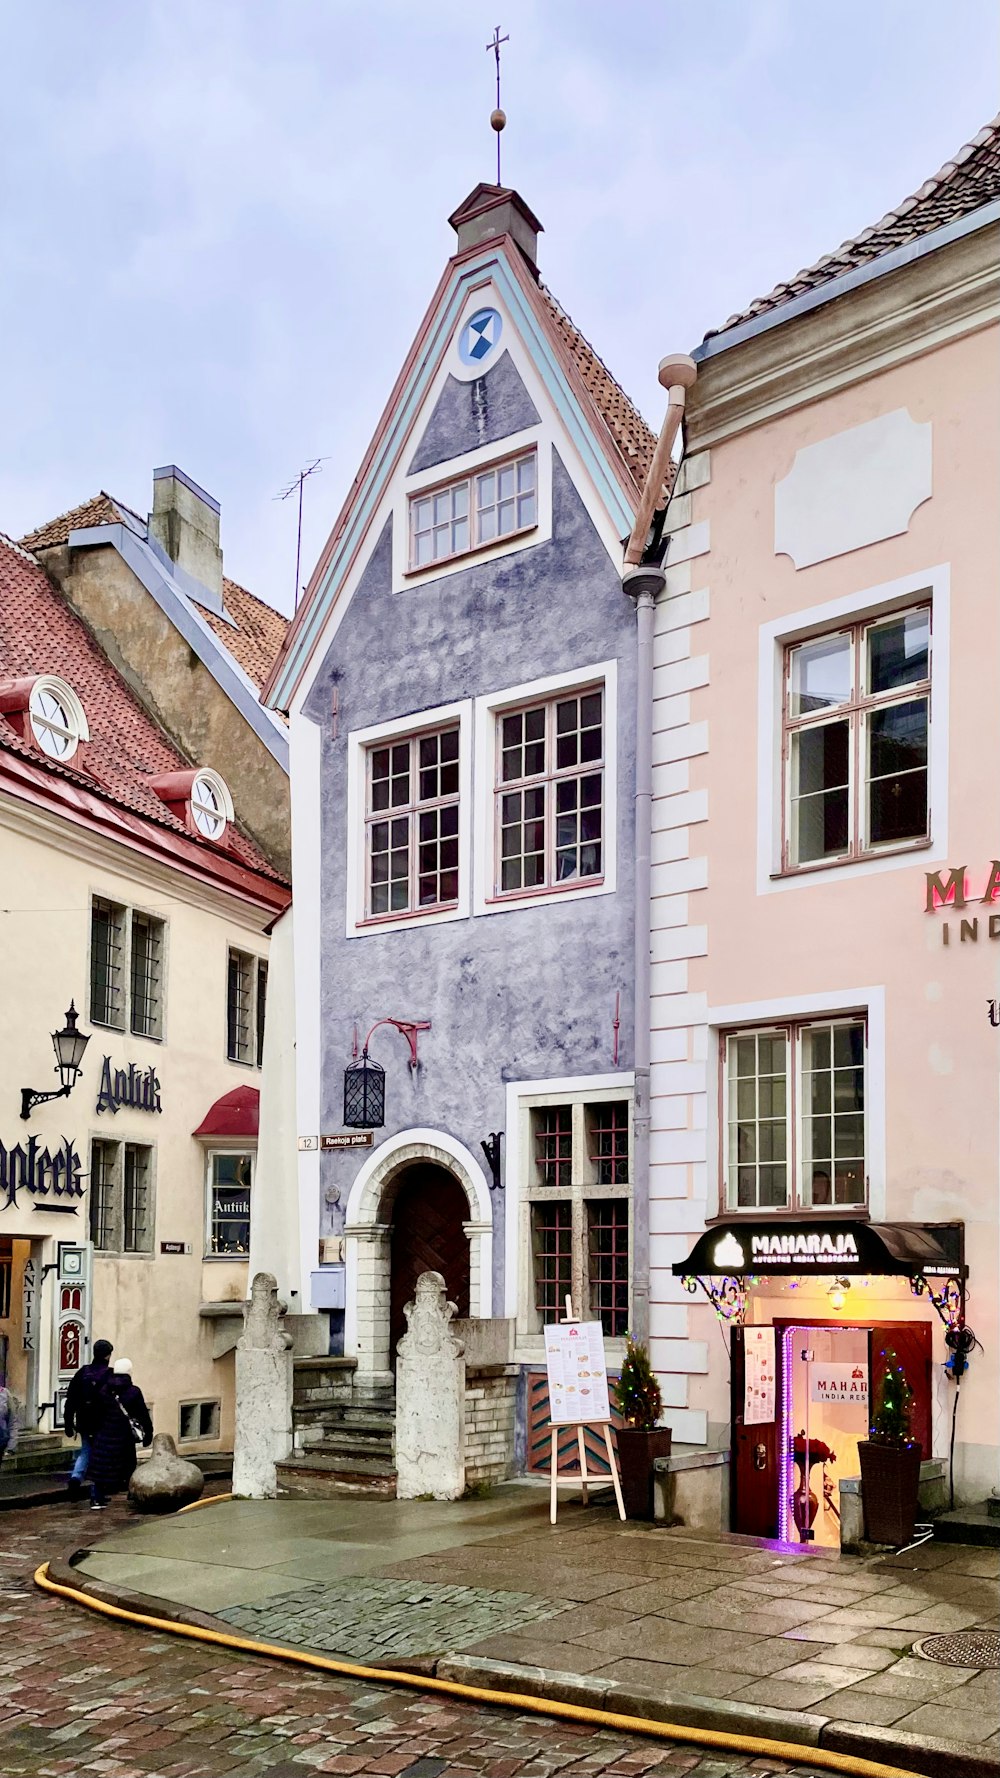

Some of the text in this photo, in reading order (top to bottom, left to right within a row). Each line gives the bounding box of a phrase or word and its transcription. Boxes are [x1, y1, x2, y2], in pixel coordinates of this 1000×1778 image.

[303, 1138, 312, 1148] 12
[351, 1135, 367, 1144] plats
[213, 1200, 249, 1213] Antiik
[751, 1233, 858, 1255] MAHARAJA
[23, 1259, 35, 1349] ANTIIK
